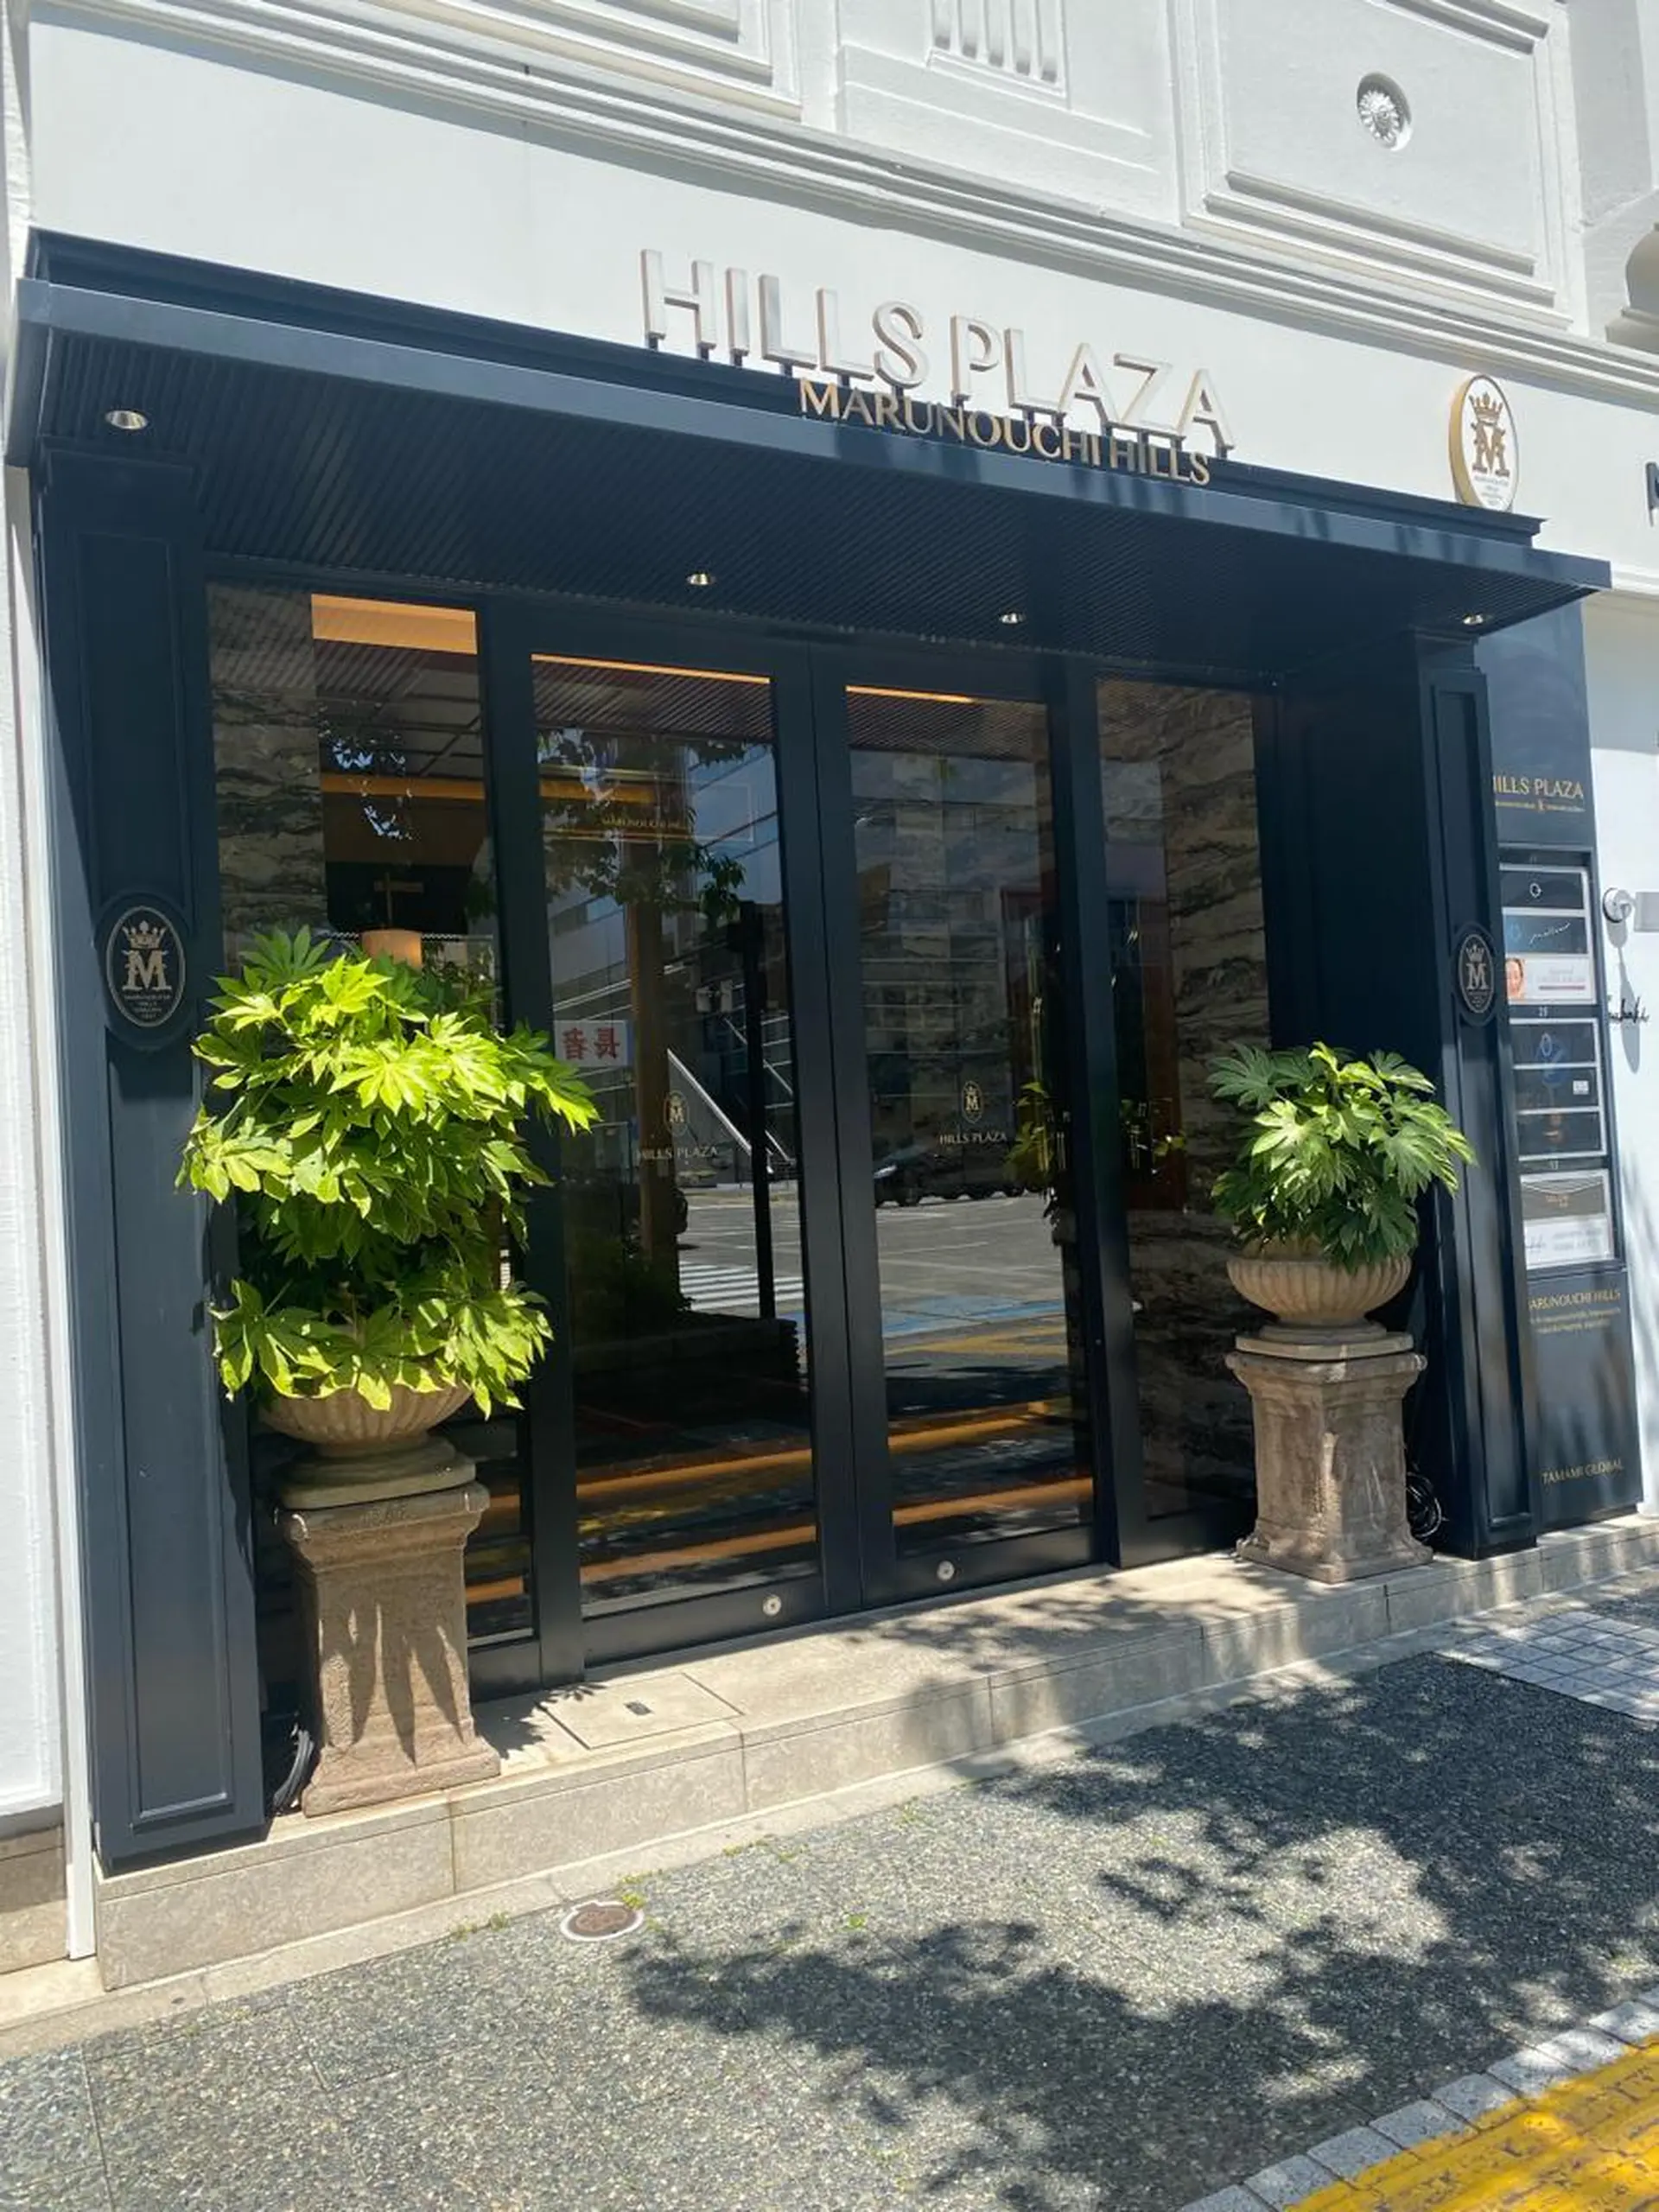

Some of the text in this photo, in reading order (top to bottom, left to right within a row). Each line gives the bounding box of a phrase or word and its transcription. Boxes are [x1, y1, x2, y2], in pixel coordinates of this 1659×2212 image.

[640, 249, 1236, 450] HILLS PLAZA
[799, 378, 1211, 486] MARUNOUCHI HILLS
[1534, 778, 1584, 799] PLAZA
[122, 950, 172, 991] M
[1465, 963, 1488, 990] M
[939, 1131, 1007, 1145] HILLS PLAZA
[677, 1146, 719, 1159] PLAZA
